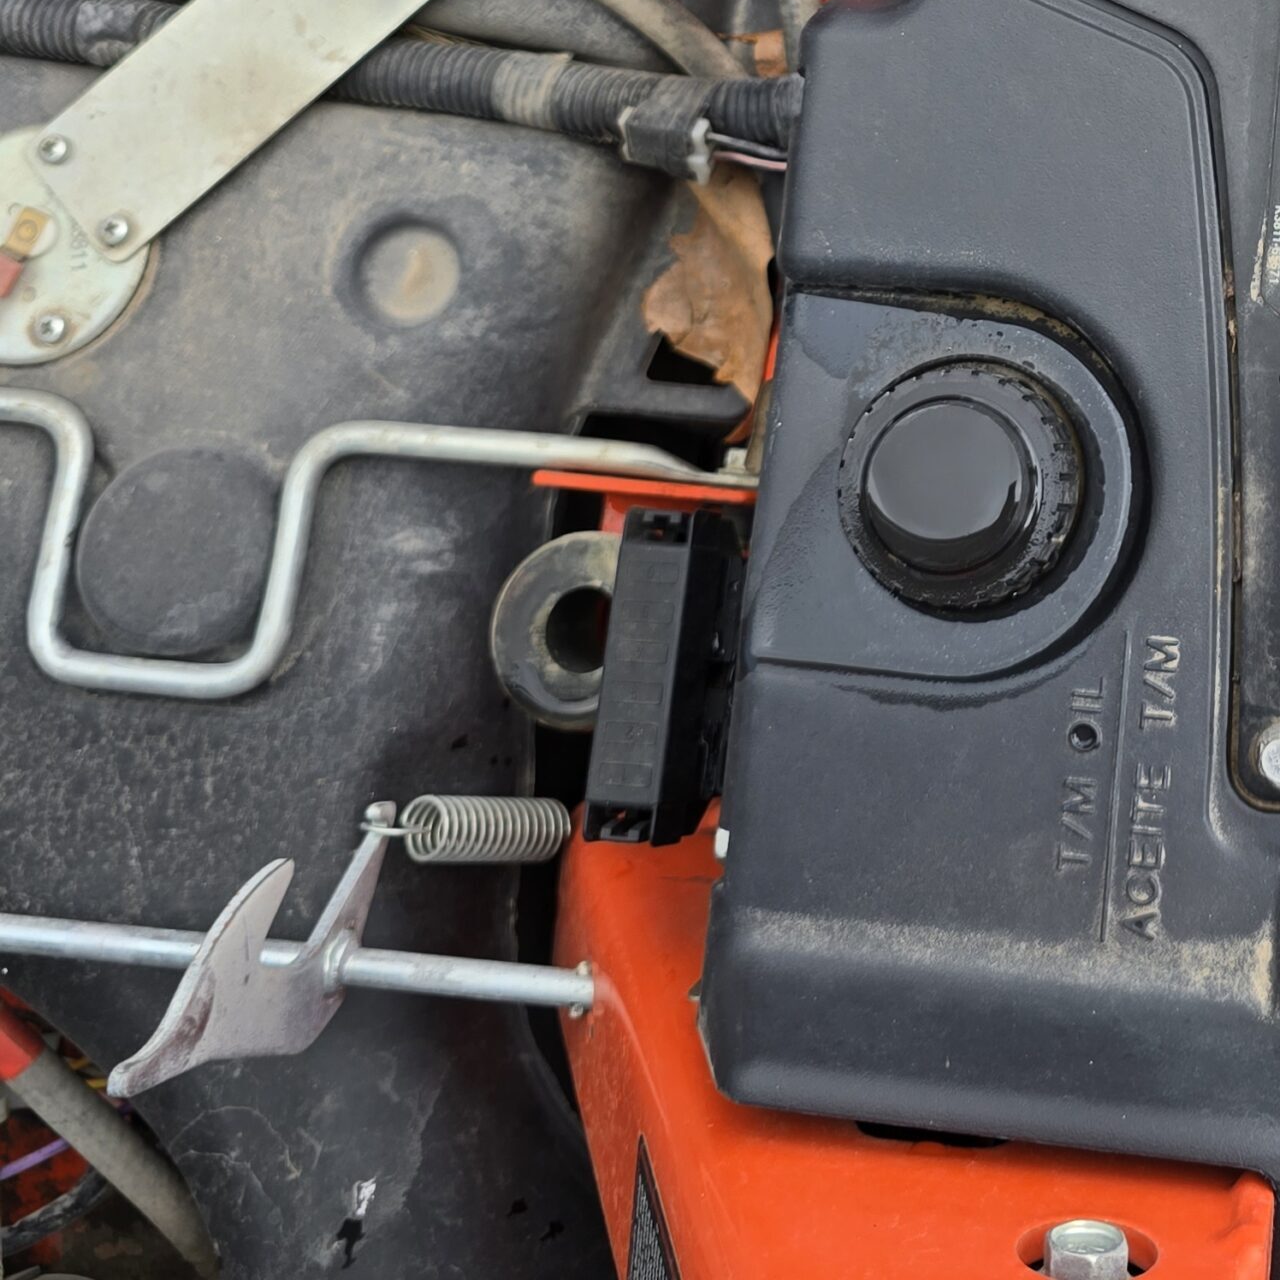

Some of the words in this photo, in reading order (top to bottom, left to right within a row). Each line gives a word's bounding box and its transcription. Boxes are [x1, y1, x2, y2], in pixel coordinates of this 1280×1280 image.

[1139, 634, 1181, 730] T/M
[1056, 775, 1099, 871] T/M
[1121, 762, 1172, 941] ACEITE
